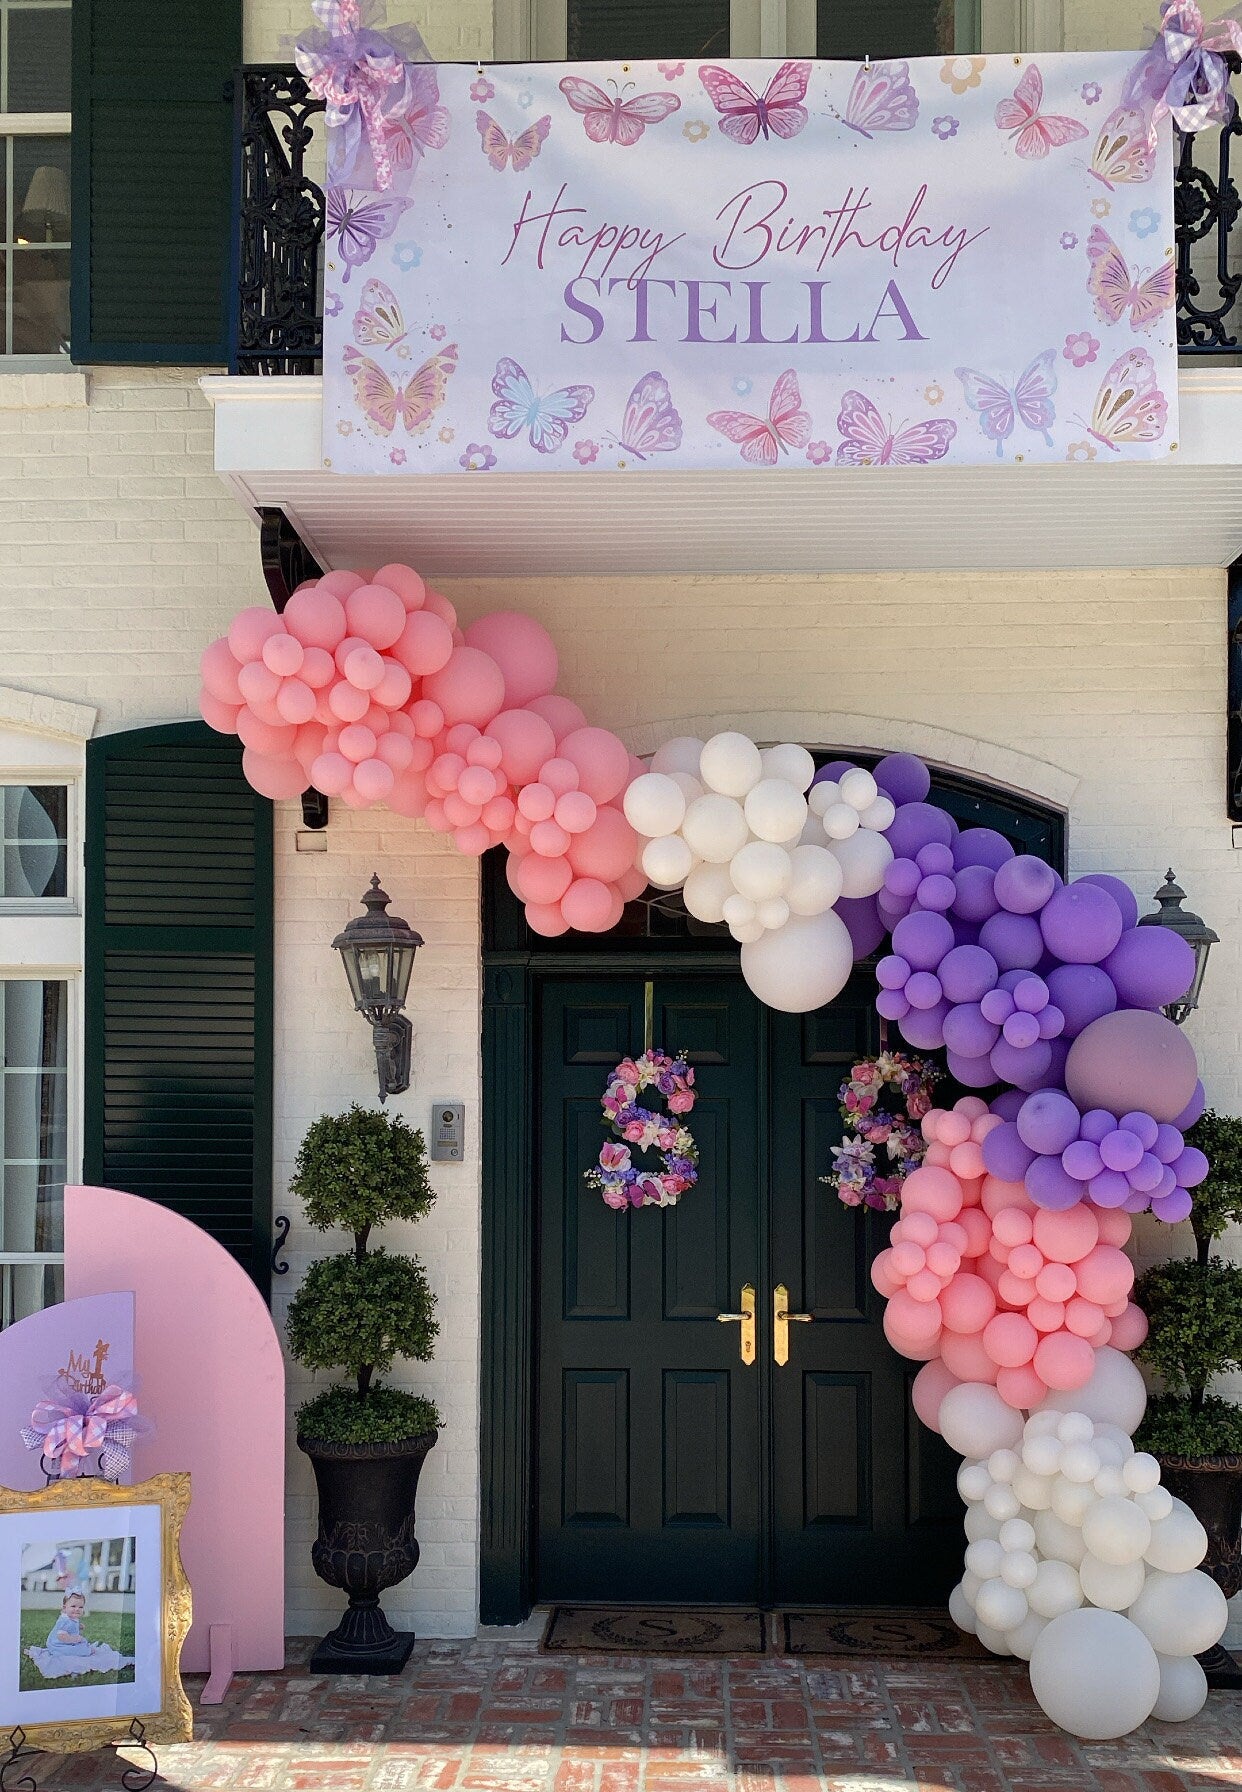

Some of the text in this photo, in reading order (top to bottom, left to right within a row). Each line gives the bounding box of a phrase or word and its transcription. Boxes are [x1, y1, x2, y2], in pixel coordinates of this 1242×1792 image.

[500, 179, 991, 290] Happy Birthday
[560, 276, 931, 345] STELLA
[636, 1618, 678, 1637] S
[872, 1624, 916, 1642] S
